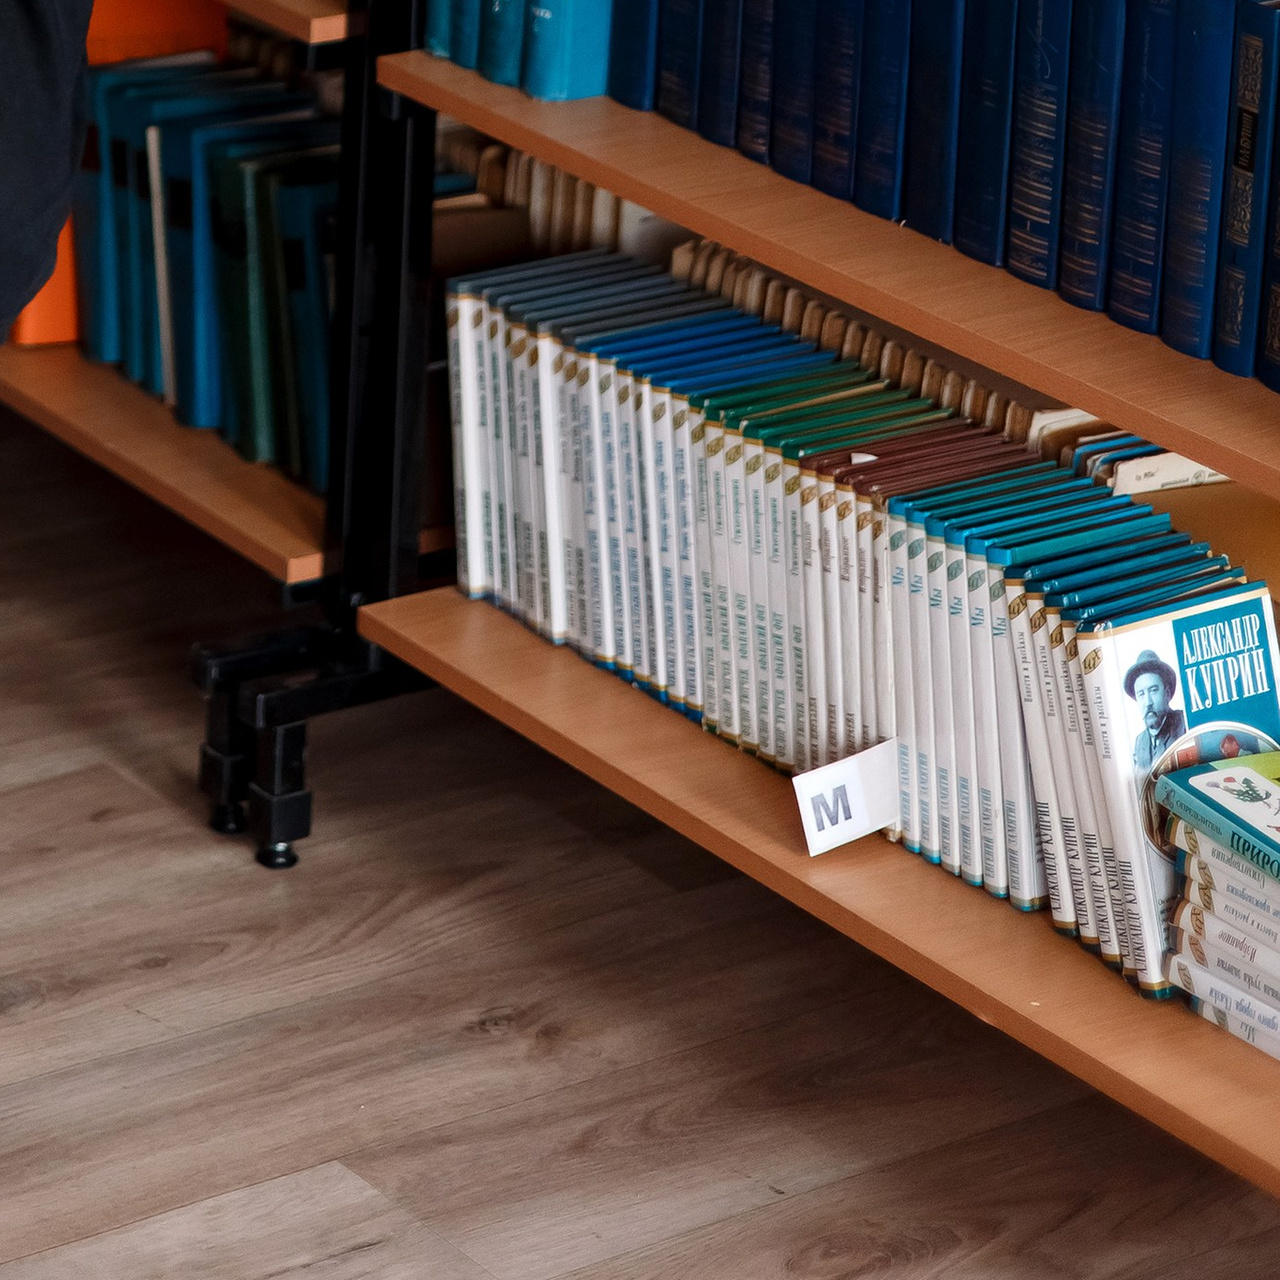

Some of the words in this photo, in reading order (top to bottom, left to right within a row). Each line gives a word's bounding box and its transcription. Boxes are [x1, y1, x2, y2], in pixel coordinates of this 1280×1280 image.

[892, 567, 905, 587] Мы
[910, 575, 923, 594] Мы
[930, 589, 943, 609] Мы
[950, 596, 963, 617] Мы
[971, 607, 985, 628] Мы
[992, 617, 1007, 637] Мы
[1182, 613, 1260, 666] АЛЕКСАНДР
[1185, 648, 1270, 713] КУПРИН
[1037, 802, 1053, 846] КУПРИН
[1062, 817, 1080, 860] КУПРИН
[1176, 800, 1223, 836] ОПРЕДЕЛИТЕЛЬ
[1084, 833, 1101, 877] КУПРИН
[1102, 847, 1120, 891] КУПРИН
[1043, 848, 1062, 913] АЛЕКСАНДР
[1070, 863, 1090, 929] АЛЕКСАНДР
[1119, 861, 1138, 905] КУПРИН
[1091, 881, 1112, 947] АЛЕКСАНДР
[1110, 895, 1130, 961] АЛЕКСАНДР
[1127, 908, 1148, 975] АЛЕКСАНДР
[1218, 930, 1257, 964] Избранное
